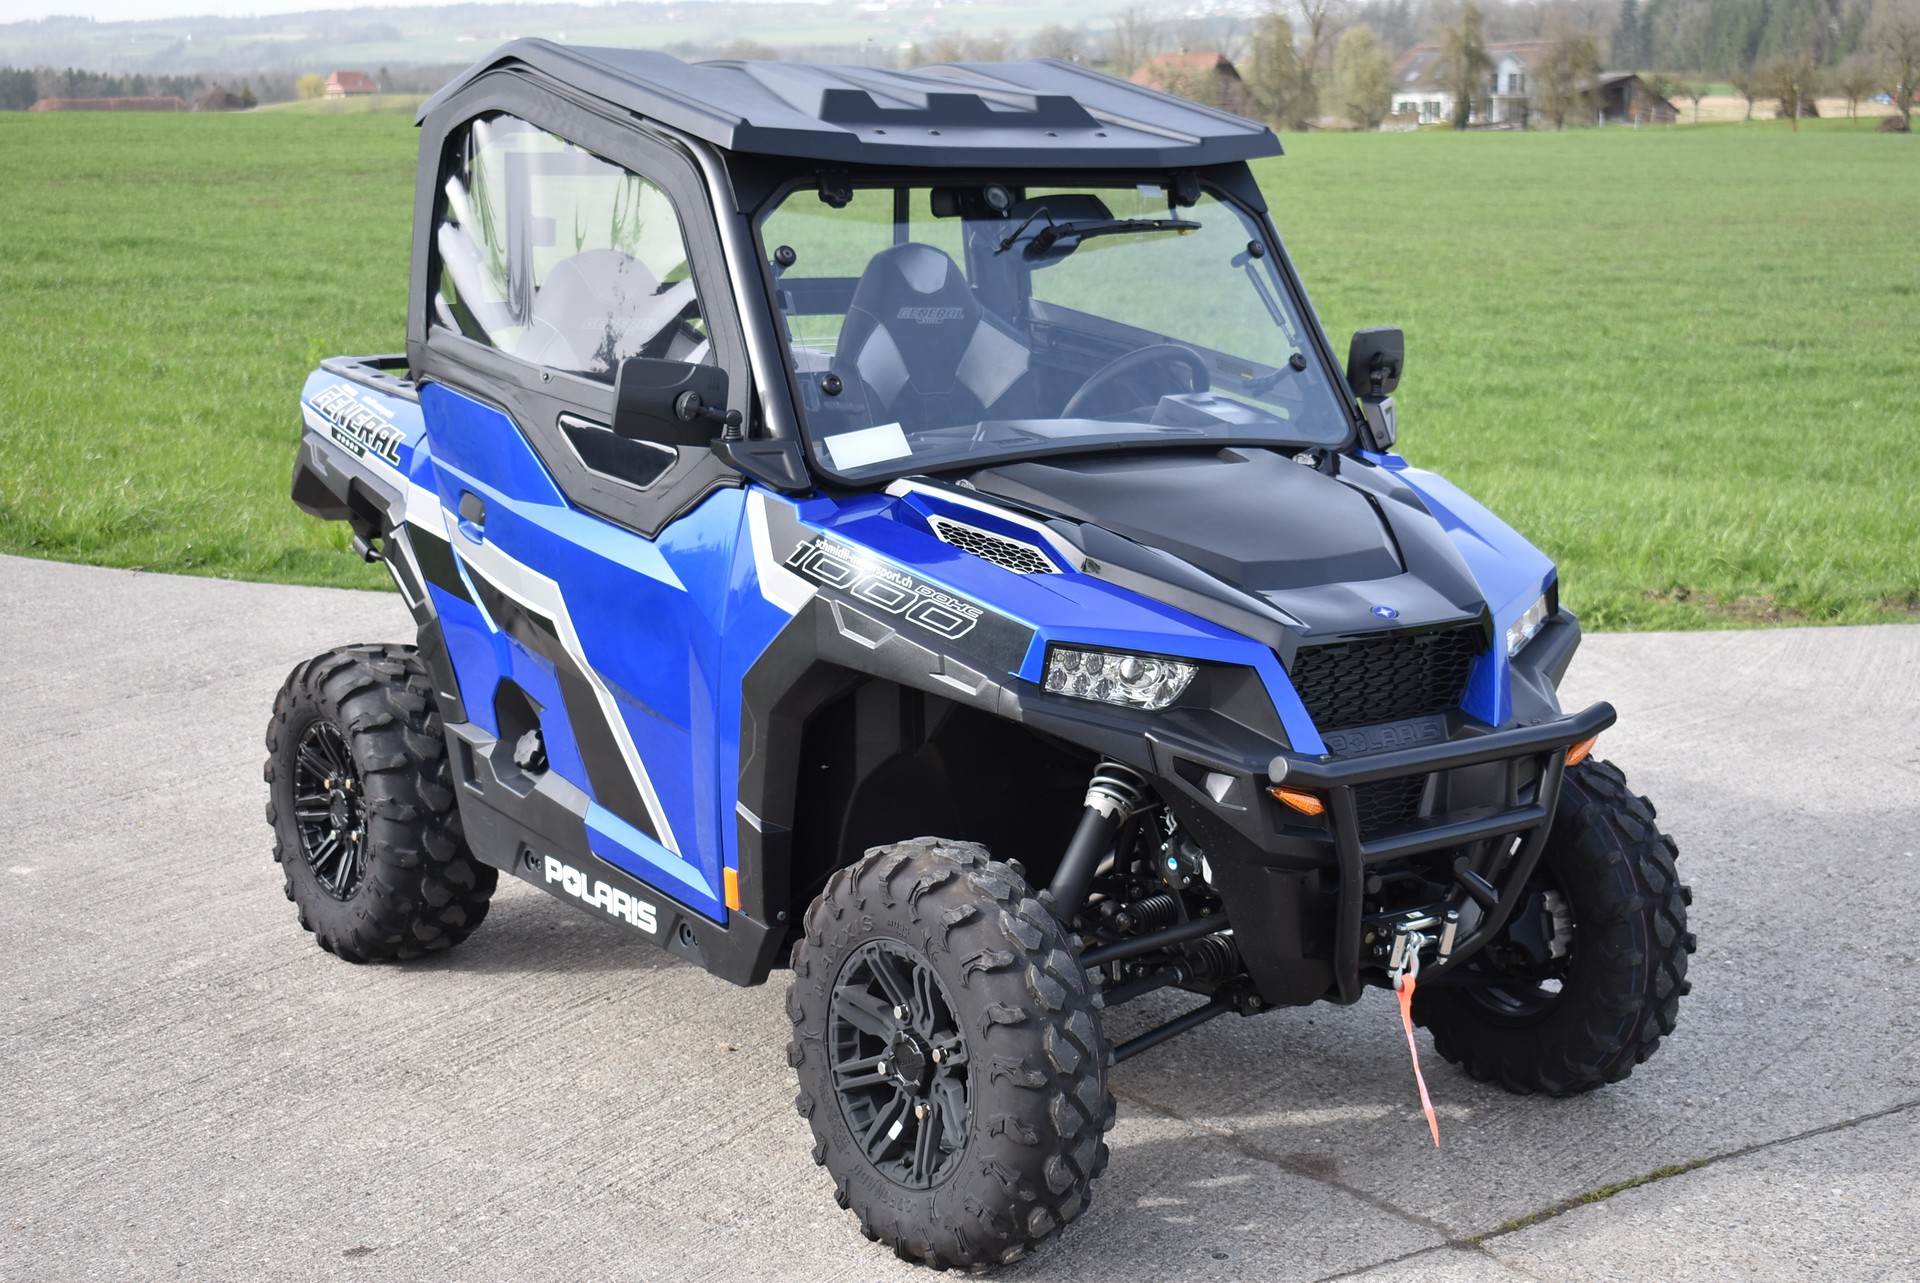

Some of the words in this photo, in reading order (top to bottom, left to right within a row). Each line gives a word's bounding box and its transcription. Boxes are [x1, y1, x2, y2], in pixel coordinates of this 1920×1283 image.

[897, 307, 964, 320] GENERAL
[310, 384, 407, 466] GENERAL
[815, 538, 913, 589] schmidli-mrsport.ch
[786, 539, 978, 640] 1000
[915, 584, 984, 618] DOHC
[1325, 719, 1438, 754] POLARIS
[544, 854, 658, 935] POLARIS
